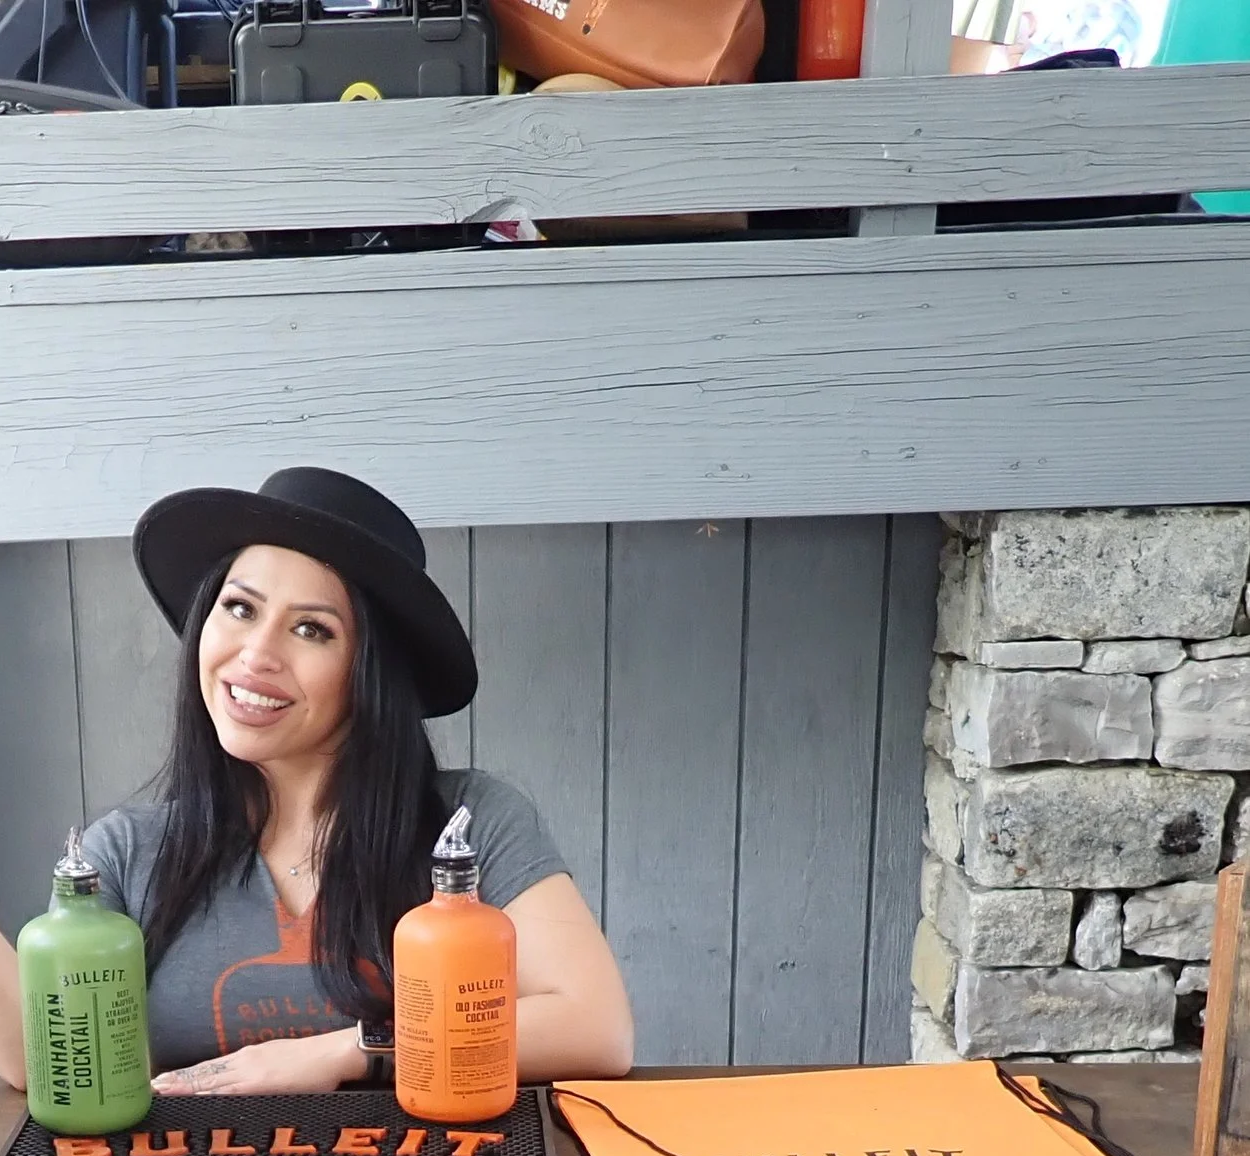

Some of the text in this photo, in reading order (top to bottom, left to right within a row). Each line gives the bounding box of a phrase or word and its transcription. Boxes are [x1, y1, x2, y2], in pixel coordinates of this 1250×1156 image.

[62, 969, 126, 987] BULLEIT
[458, 979, 505, 994] BULLEIT
[238, 995, 333, 1021] BULL
[456, 1002, 469, 1012] OLD
[466, 1010, 499, 1023] COCKTAIL
[47, 993, 71, 1106] MANHATTAN
[70, 1012, 92, 1089] COCKTAIL
